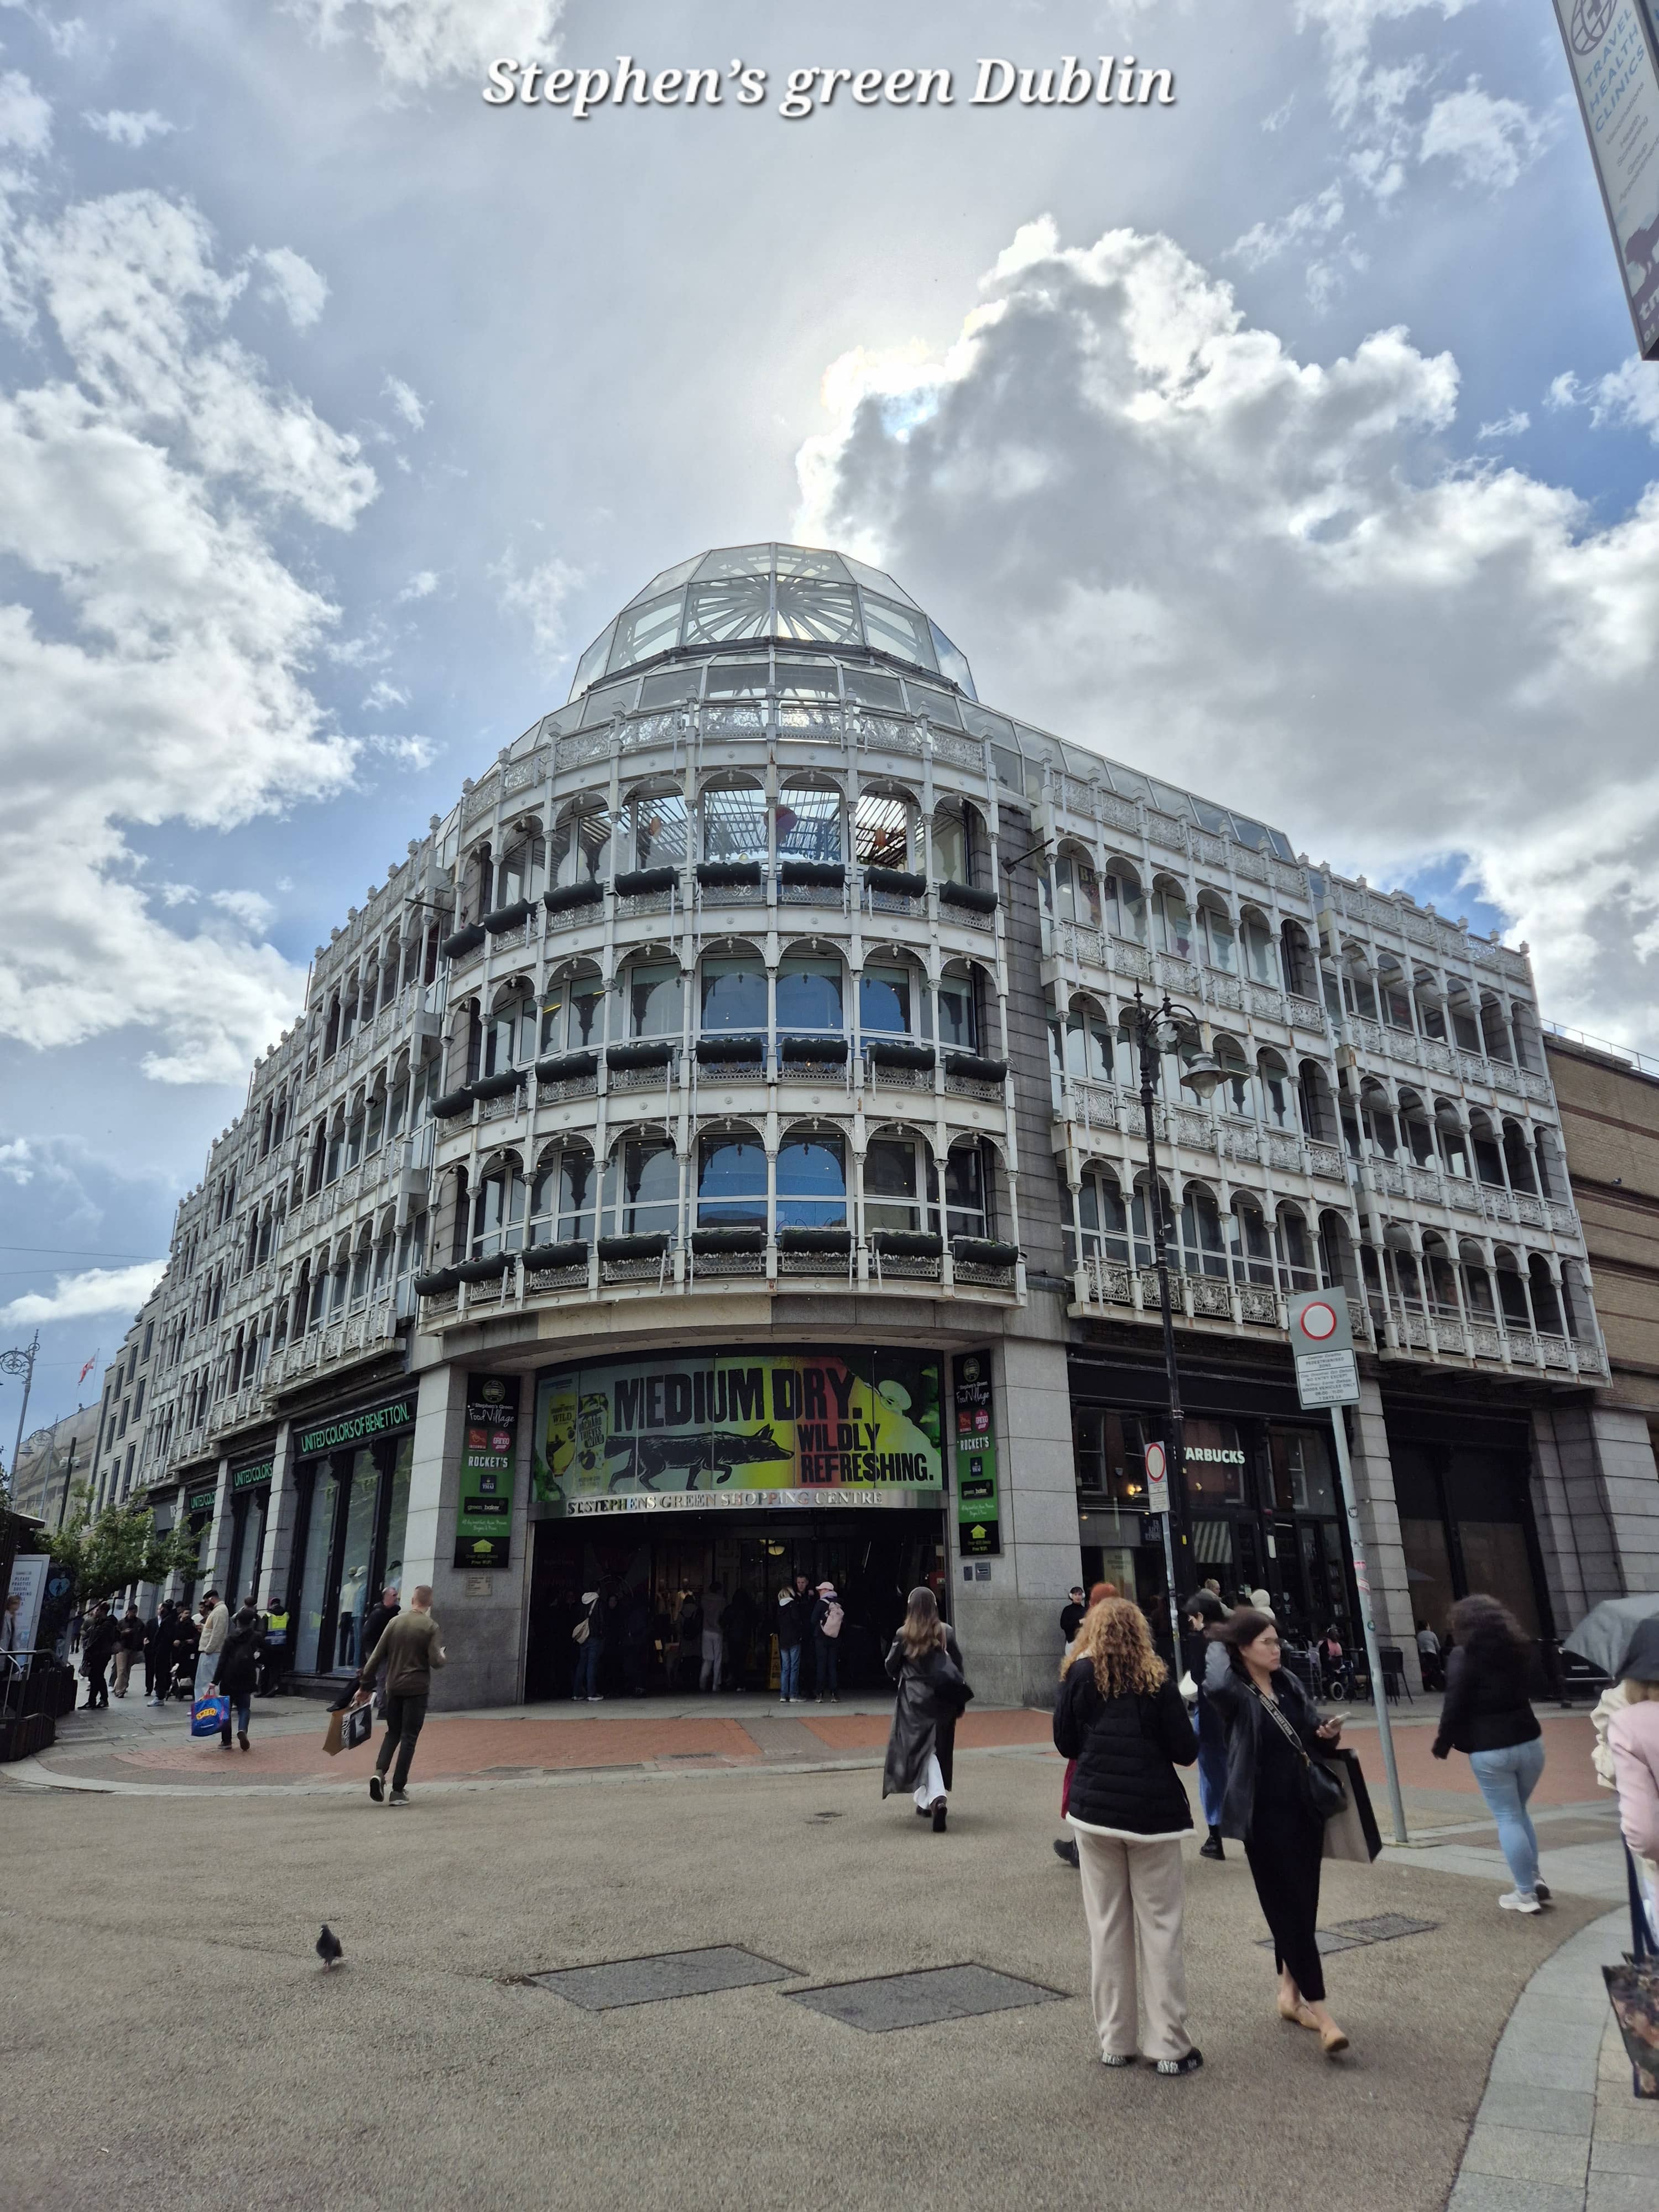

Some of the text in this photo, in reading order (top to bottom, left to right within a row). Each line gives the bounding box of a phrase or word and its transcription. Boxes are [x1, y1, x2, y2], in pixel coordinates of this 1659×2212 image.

[1584, 9, 1631, 88] TRAVEL
[1590, 23, 1638, 113] HEALTH
[1595, 44, 1645, 133] CLINICS
[614, 1368, 862, 1432] MEDIUM DRY.
[956, 1387, 990, 1405] Food Village
[469, 1408, 515, 1428] Food Village
[301, 1430, 325, 1453] UNITED
[325, 1422, 354, 1446] COLORS
[354, 1416, 365, 1437] OF
[797, 1423, 880, 1453] WILDLY
[468, 1455, 508, 1468] ROCKET'S
[1173, 1445, 1246, 1465] ARBUCKS
[234, 1469, 252, 1486] UNITED
[801, 1453, 934, 1483] REFRESHING.
[205, 1491, 216, 1505] COLO
[660, 1494, 717, 1509] GREEN
[721, 1492, 809, 1506] SHOPPING
[814, 1491, 883, 1505] CENTRE
[1259, 1694, 1274, 1711] LOUIS
